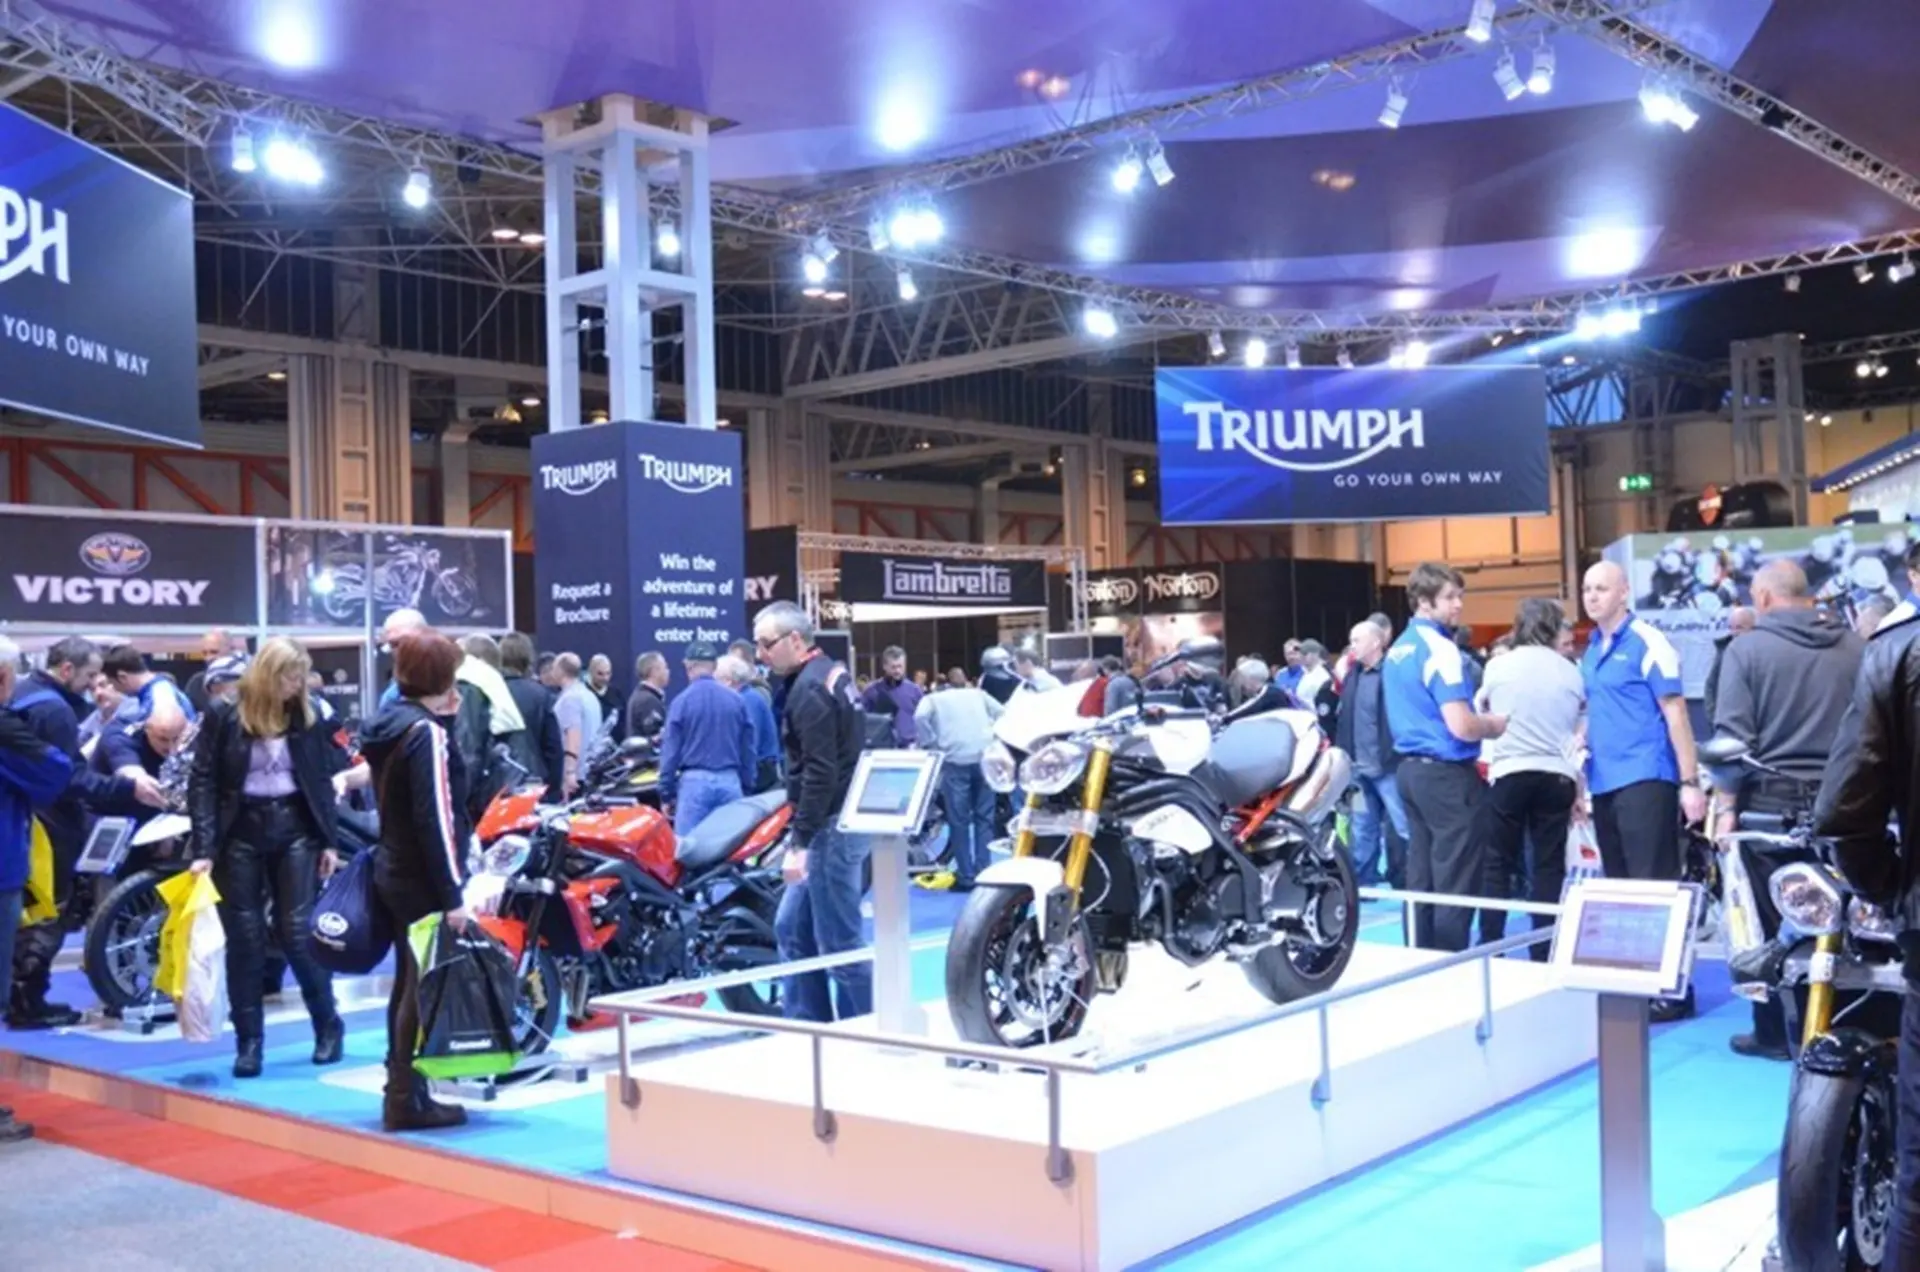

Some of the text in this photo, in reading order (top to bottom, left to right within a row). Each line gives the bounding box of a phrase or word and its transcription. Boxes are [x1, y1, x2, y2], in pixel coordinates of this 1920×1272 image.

[3, 314, 150, 377] YOUR OWN WAY
[1182, 401, 1424, 471] TRIUMPH
[540, 459, 617, 495] TRIUMPH
[638, 453, 732, 493] TRIUMPH
[1334, 471, 1502, 487] GO YOUR OWN WAY
[660, 553, 716, 571] Win the
[14, 575, 210, 605] VICTORY
[643, 577, 734, 595] adventure of
[882, 559, 1011, 600] Lambretta
[1143, 572, 1219, 602] Norton
[552, 583, 612, 602] Request a
[555, 606, 610, 624] Brochure
[652, 605, 660, 618] a
[664, 602, 717, 618] lifetime
[655, 626, 729, 643] enter here
